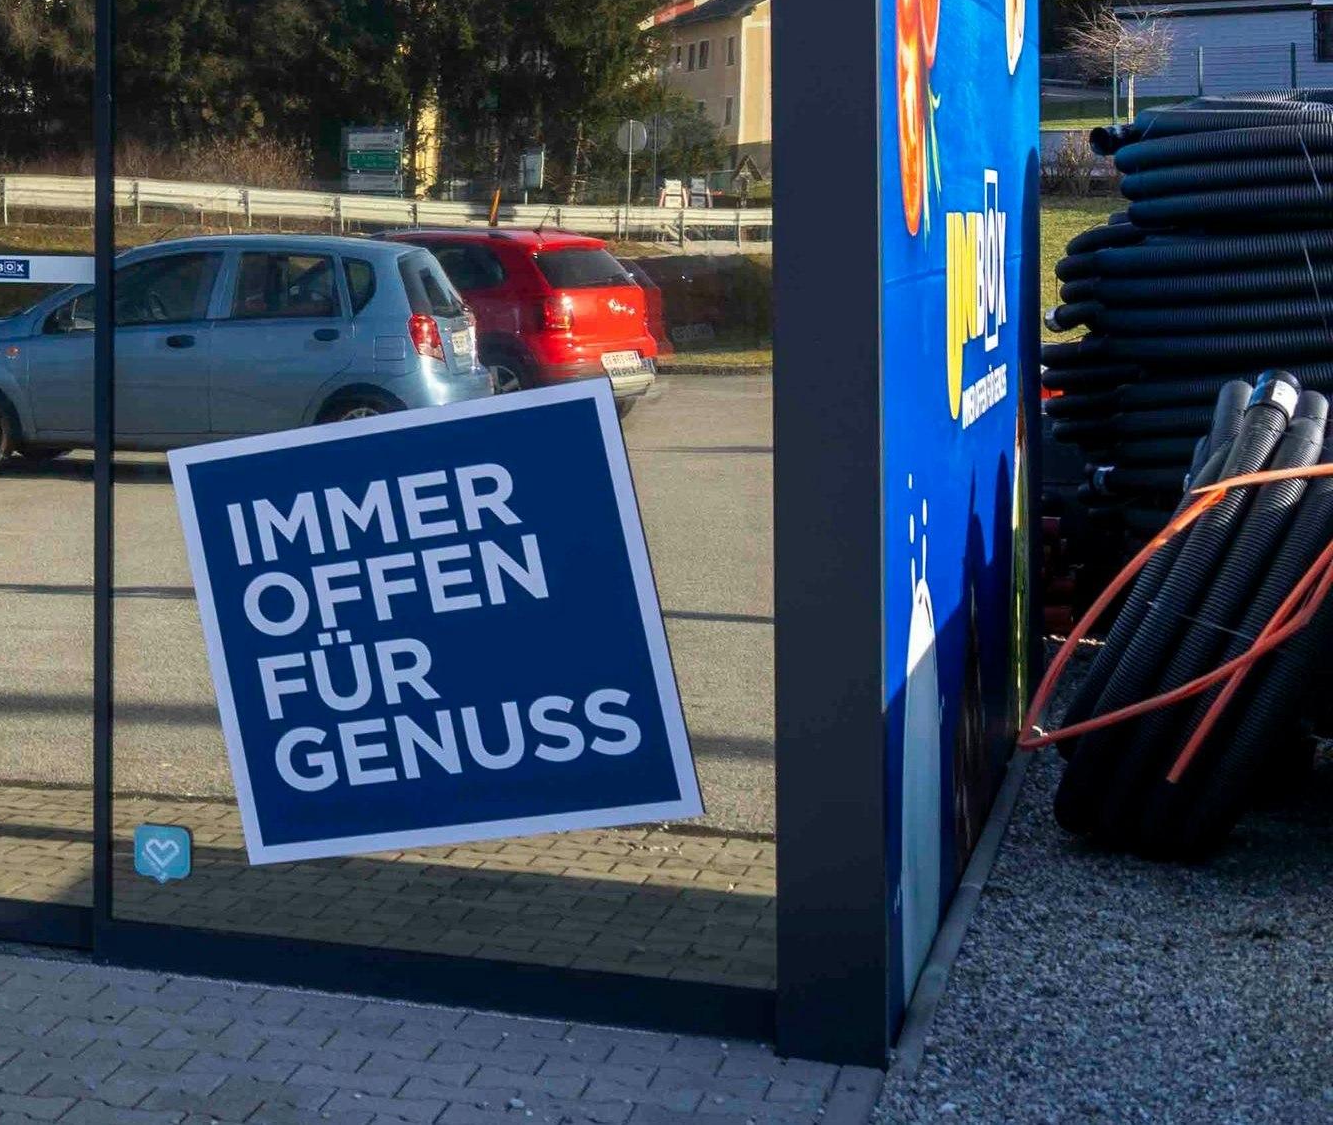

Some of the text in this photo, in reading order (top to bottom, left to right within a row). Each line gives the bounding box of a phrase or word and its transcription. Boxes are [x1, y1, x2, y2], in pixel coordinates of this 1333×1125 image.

[226, 462, 523, 566] IMMER
[243, 533, 550, 637] OFFEN
[257, 628, 441, 720] FÜR
[274, 688, 642, 793] GENUSS
